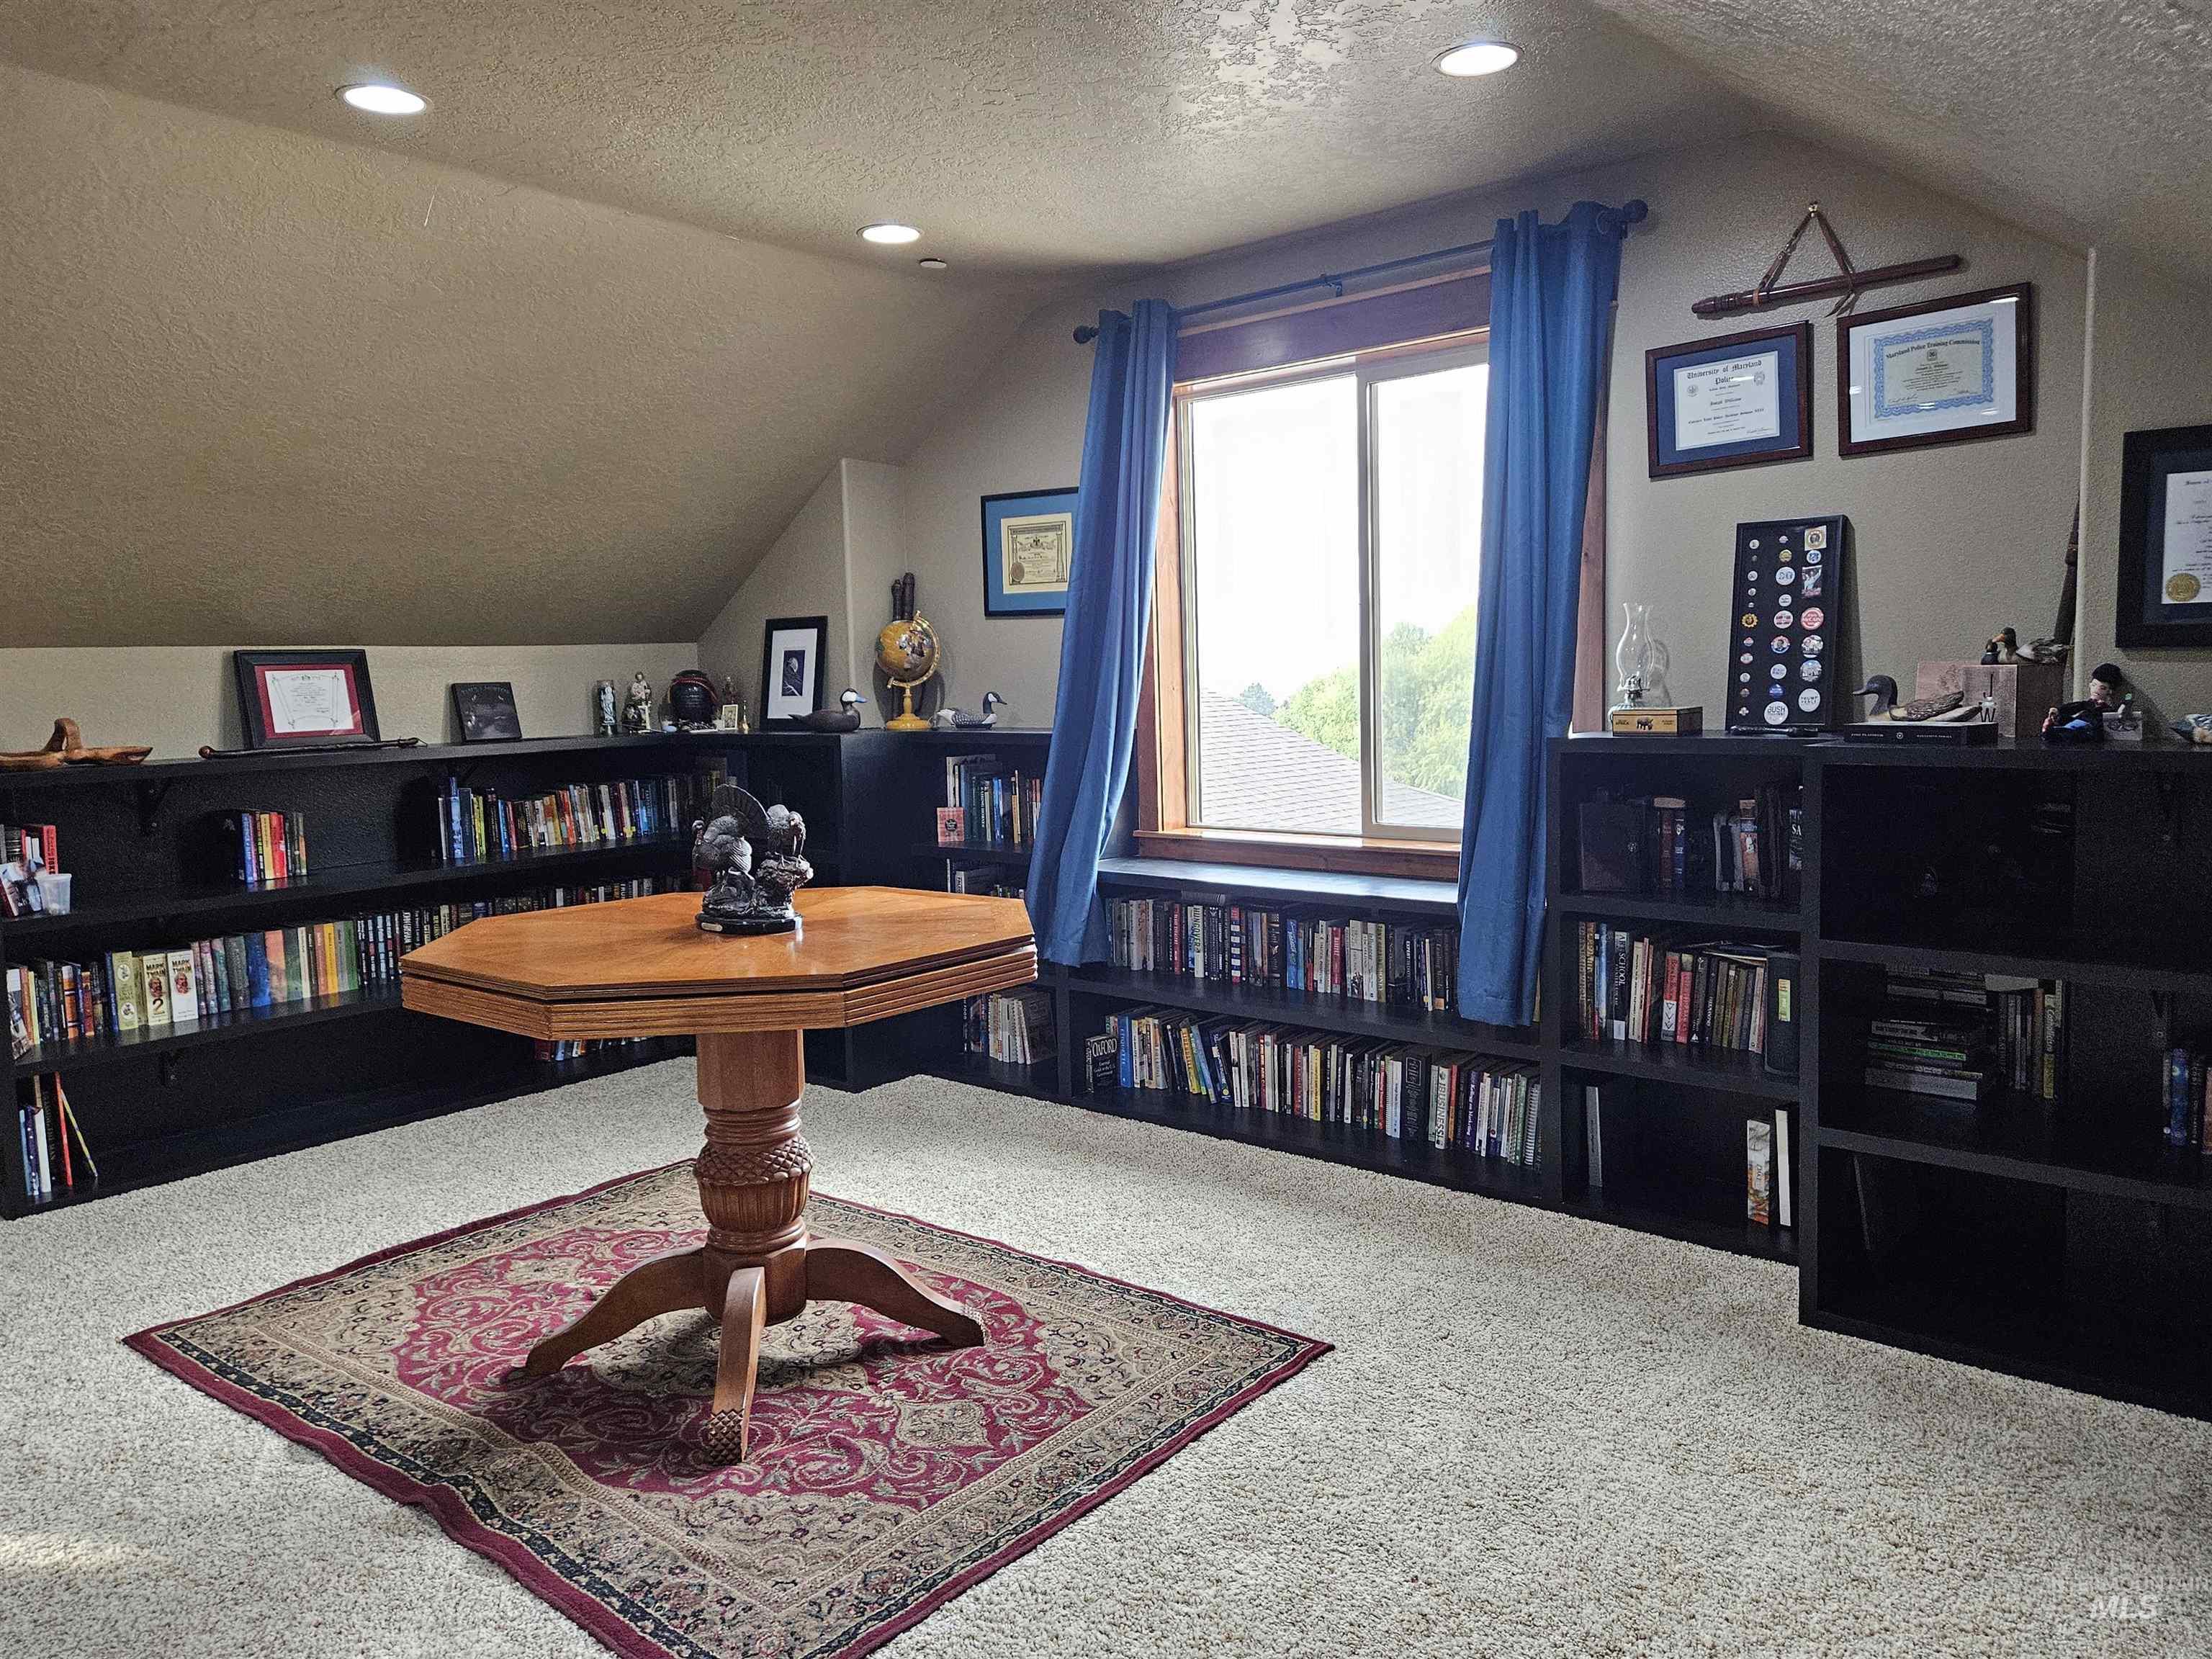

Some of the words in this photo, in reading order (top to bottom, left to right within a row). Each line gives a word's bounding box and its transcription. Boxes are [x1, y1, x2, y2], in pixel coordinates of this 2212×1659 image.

[1885, 346, 1910, 359] Maryland
[1910, 344, 1926, 354] Police
[1926, 341, 1948, 350] Training
[1948, 338, 1981, 347] Commission
[1687, 369, 1719, 379] University
[1722, 364, 1729, 373] of
[1732, 359, 1762, 372] Maryland
[146, 968, 166, 976] TWAIN
[173, 965, 192, 974] TWAIN
[1618, 952, 1627, 986] SCHOOL
[152, 998, 164, 1015] 2
[1092, 1038, 1118, 1057] OXFORD
